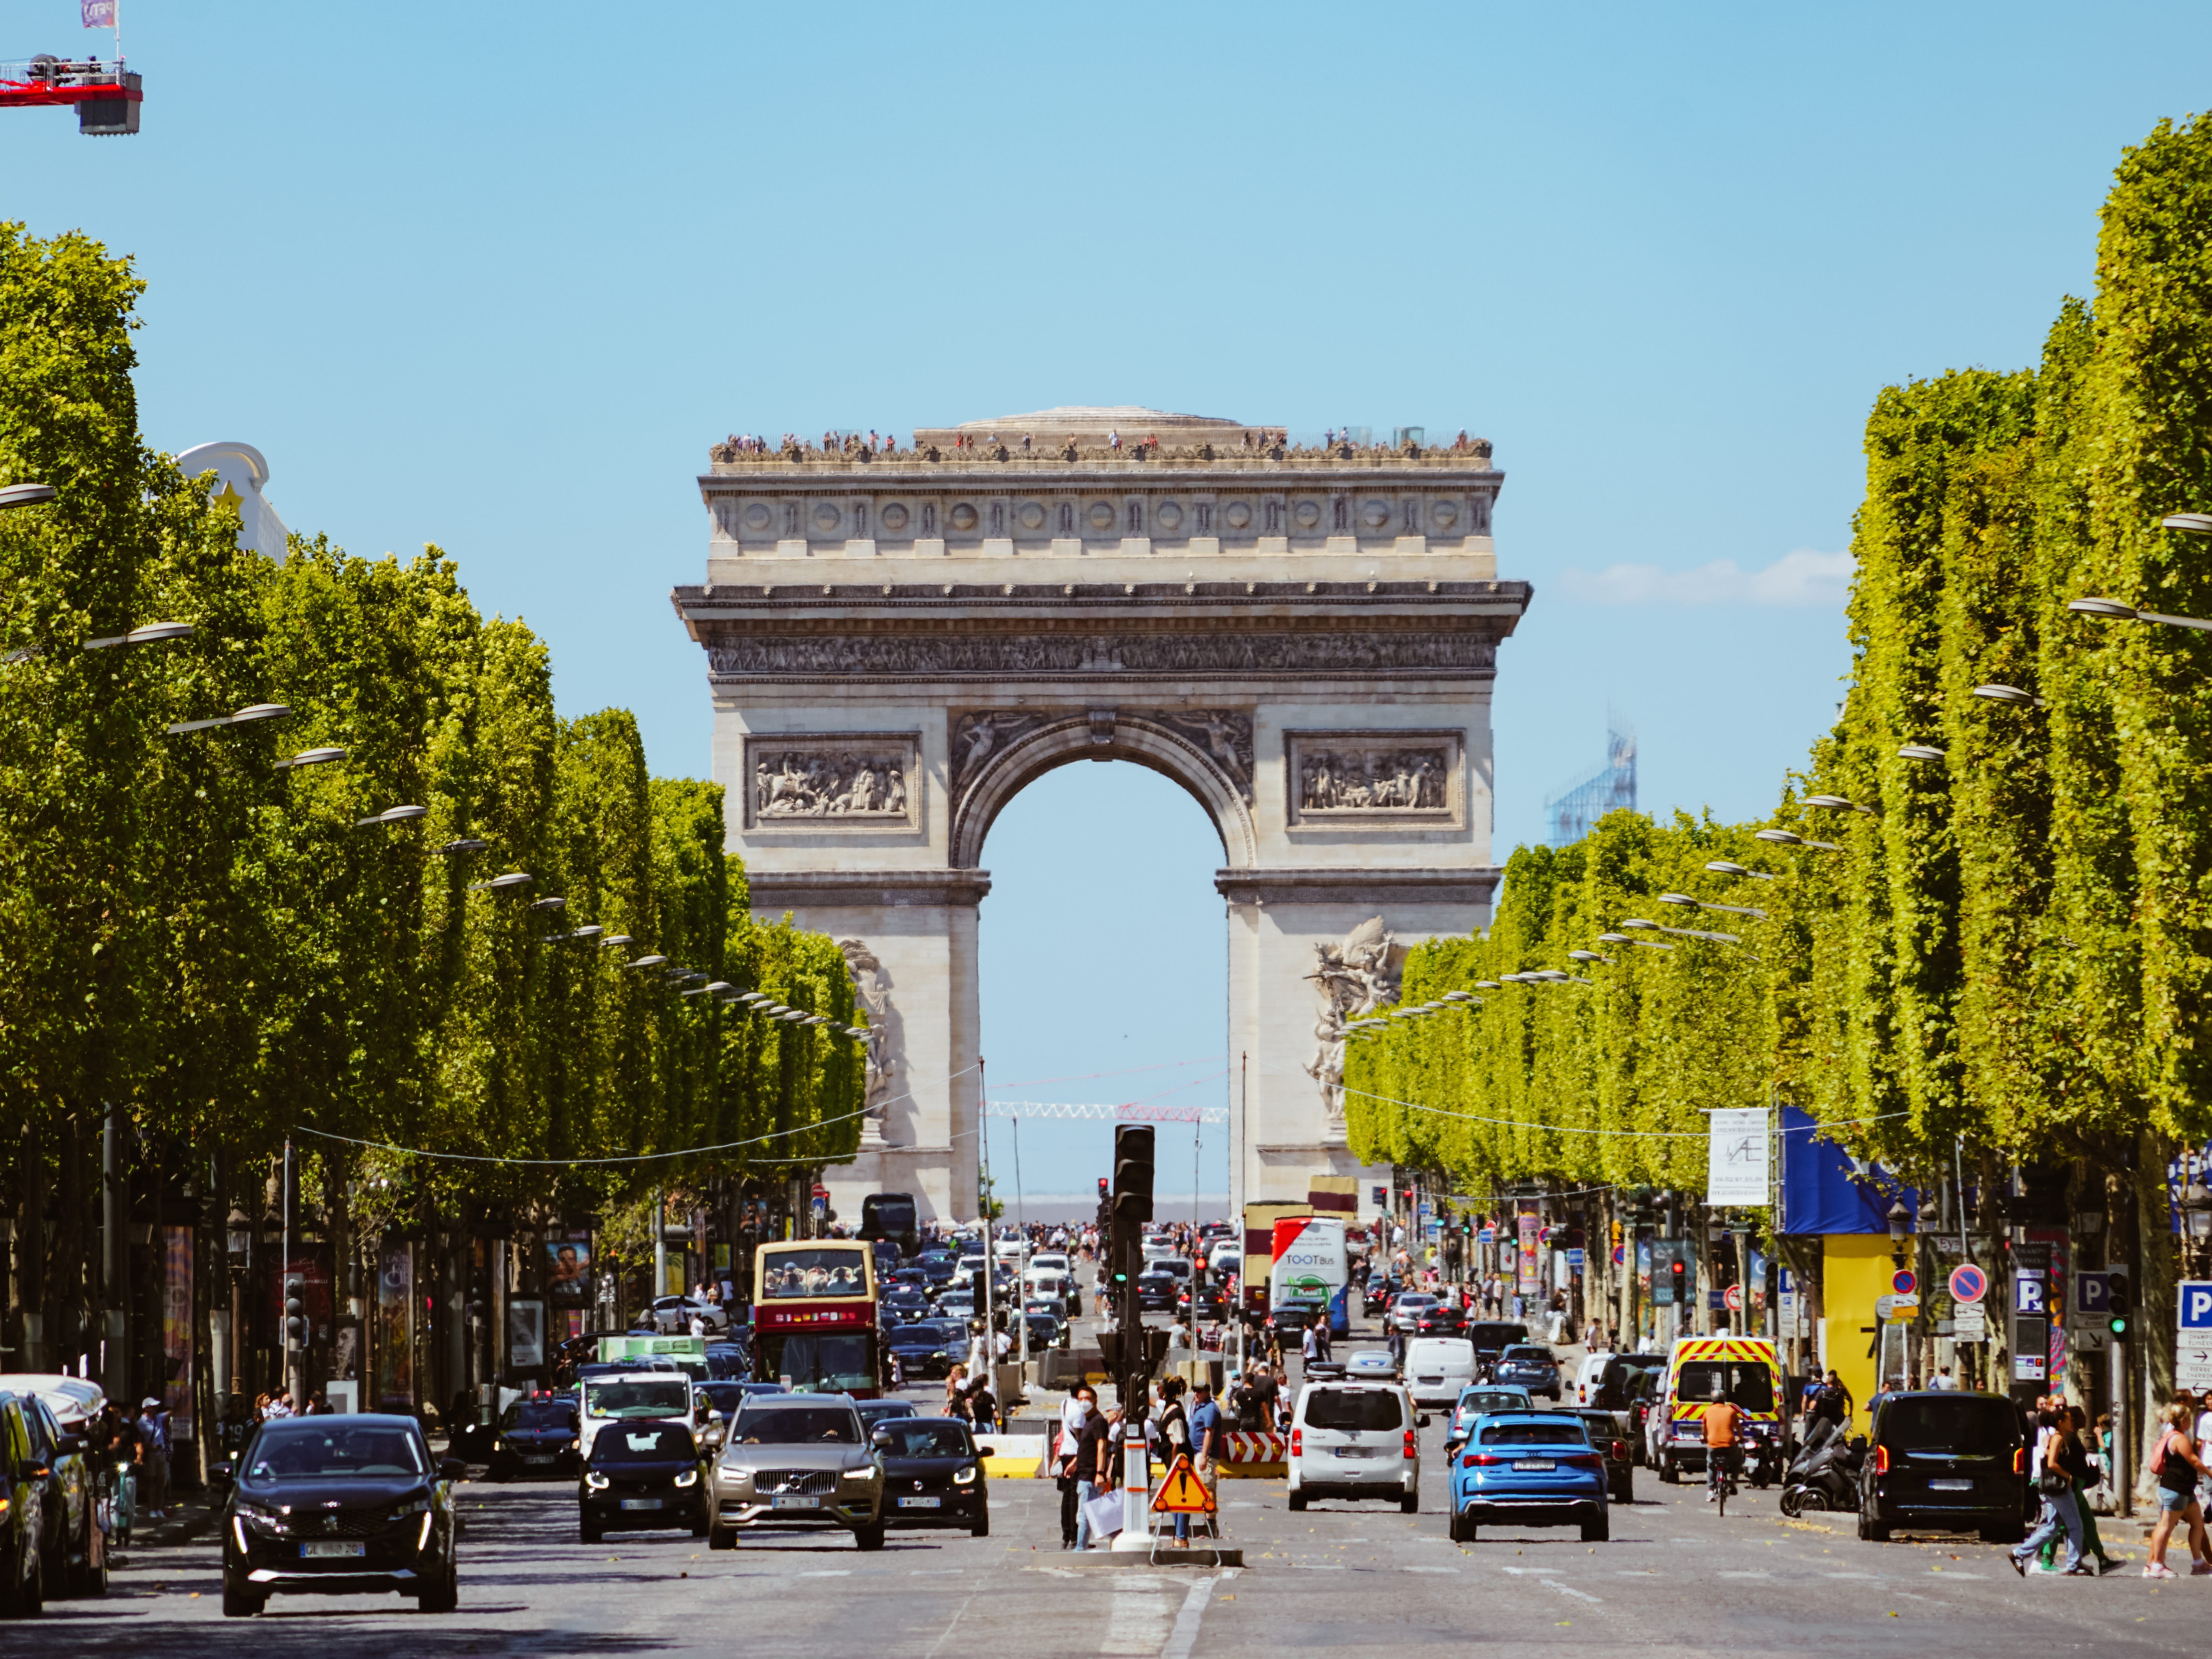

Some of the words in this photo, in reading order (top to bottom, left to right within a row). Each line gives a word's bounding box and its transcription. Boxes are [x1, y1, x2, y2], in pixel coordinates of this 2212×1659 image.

[2086, 1280, 2102, 1305] P
[2191, 1292, 2212, 1321] P
[228, 1425, 244, 1442] 19
